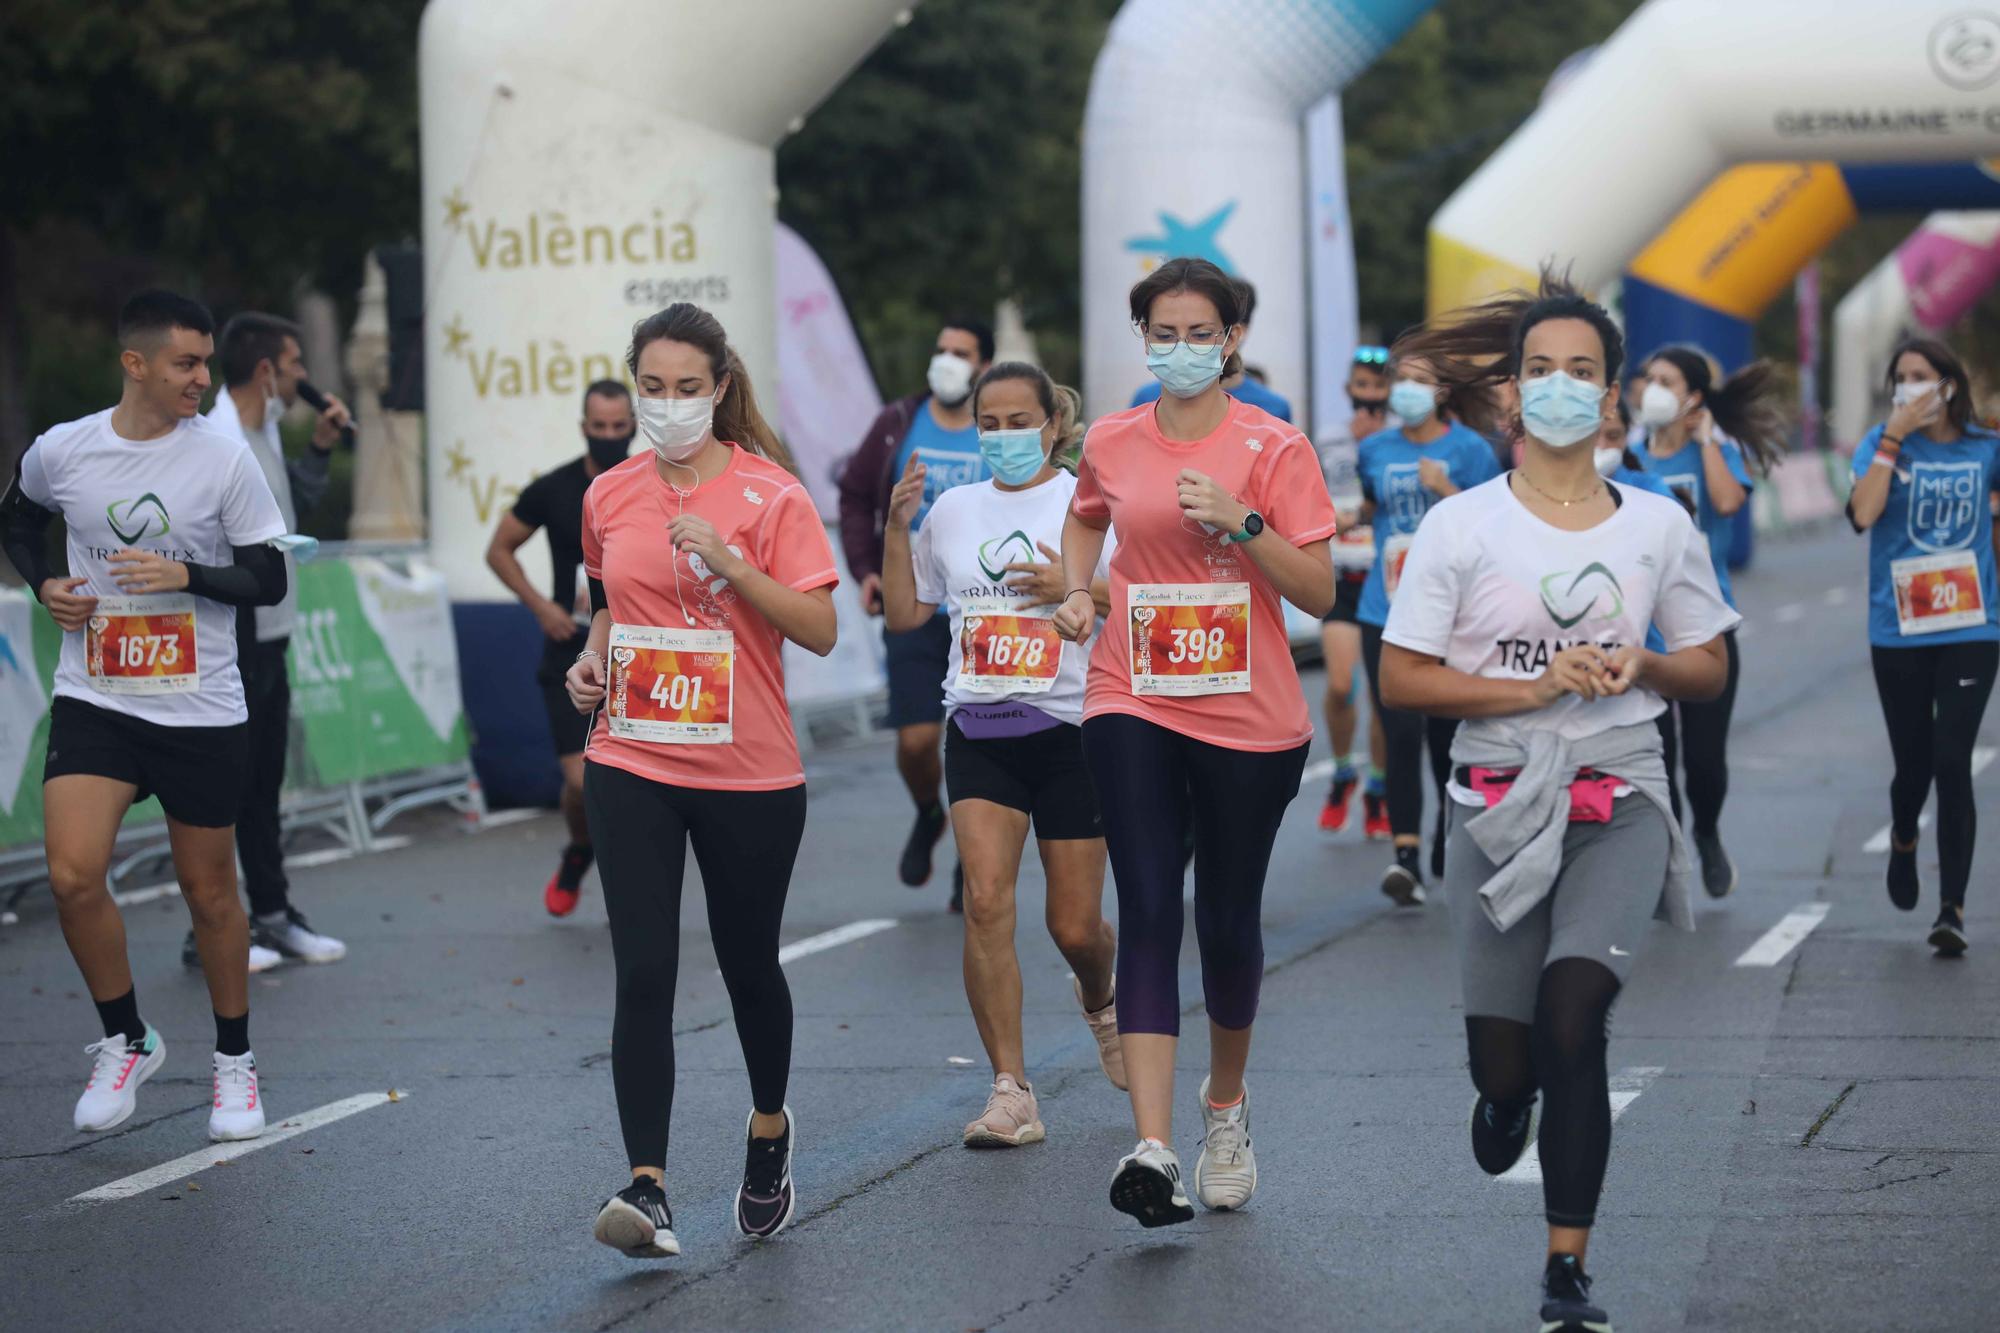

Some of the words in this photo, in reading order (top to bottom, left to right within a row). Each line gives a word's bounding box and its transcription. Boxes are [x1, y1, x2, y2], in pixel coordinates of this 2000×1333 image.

[467, 207, 698, 271] València
[623, 276, 730, 306] esports
[1917, 500, 1974, 530] CUP
[960, 584, 1033, 598] TRANS
[1931, 581, 1958, 610] 20
[118, 634, 179, 667] 1673
[986, 634, 1046, 668] 1678
[1168, 627, 1226, 664] 398
[650, 673, 702, 711] 401
